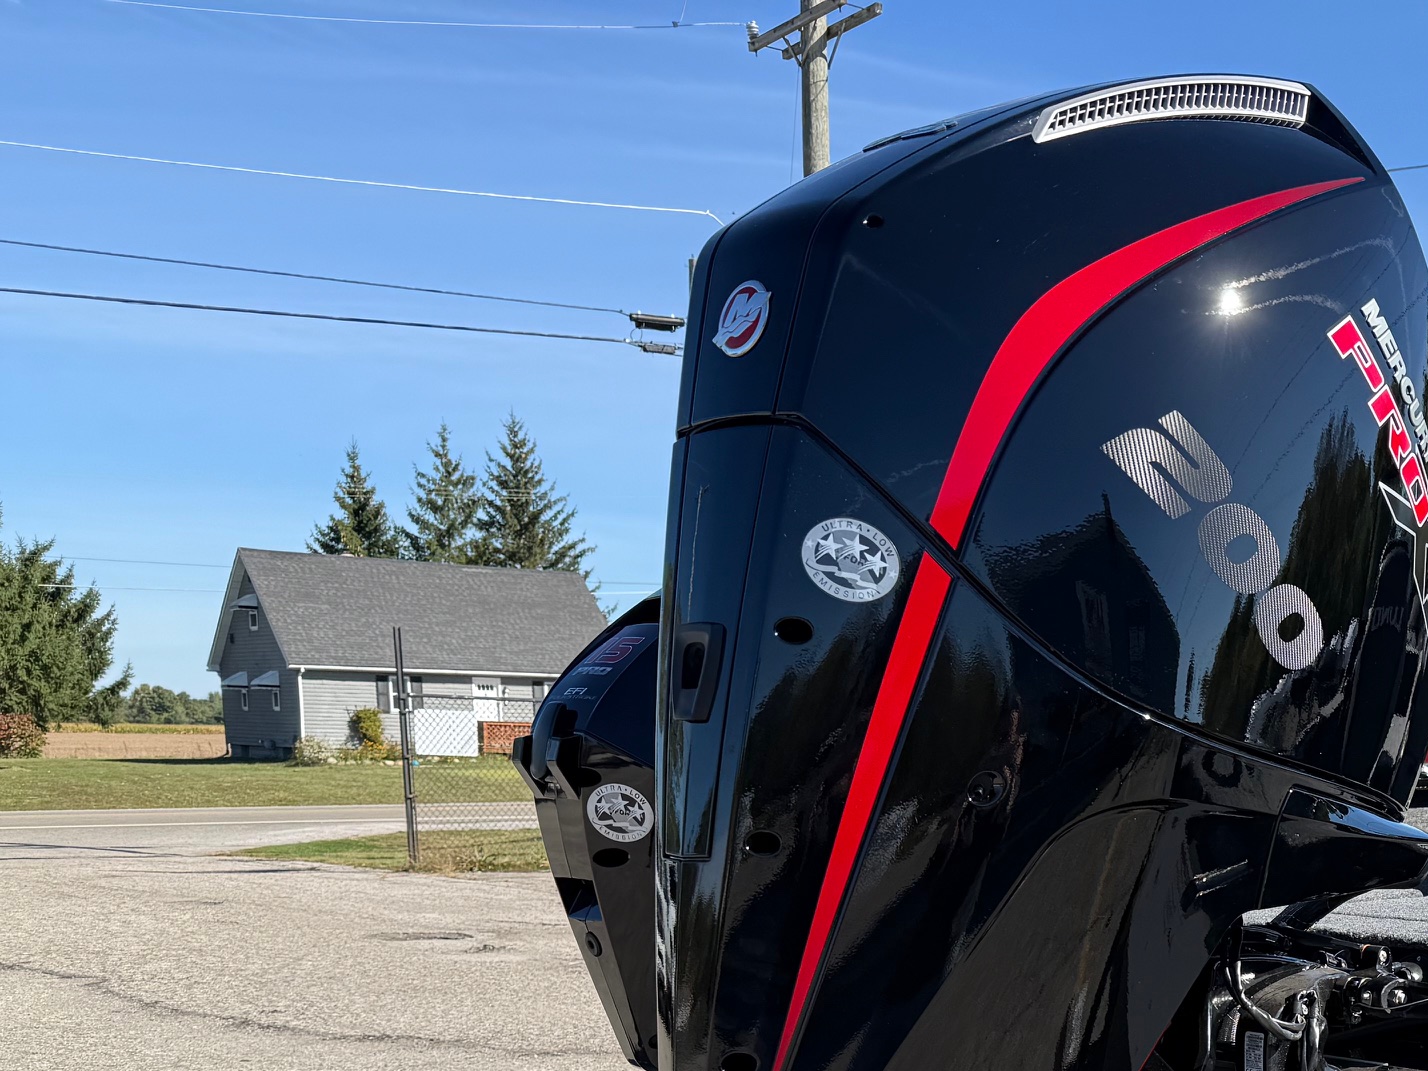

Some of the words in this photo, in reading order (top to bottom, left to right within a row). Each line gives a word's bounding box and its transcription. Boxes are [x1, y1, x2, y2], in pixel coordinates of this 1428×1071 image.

[821, 520, 864, 532] ULTRA
[872, 532, 895, 558] LOW
[1100, 410, 1323, 670] 200
[812, 571, 875, 600] EMISSION
[563, 687, 588, 695] EFI
[595, 784, 622, 796] ULTRA
[629, 789, 647, 804] LOW
